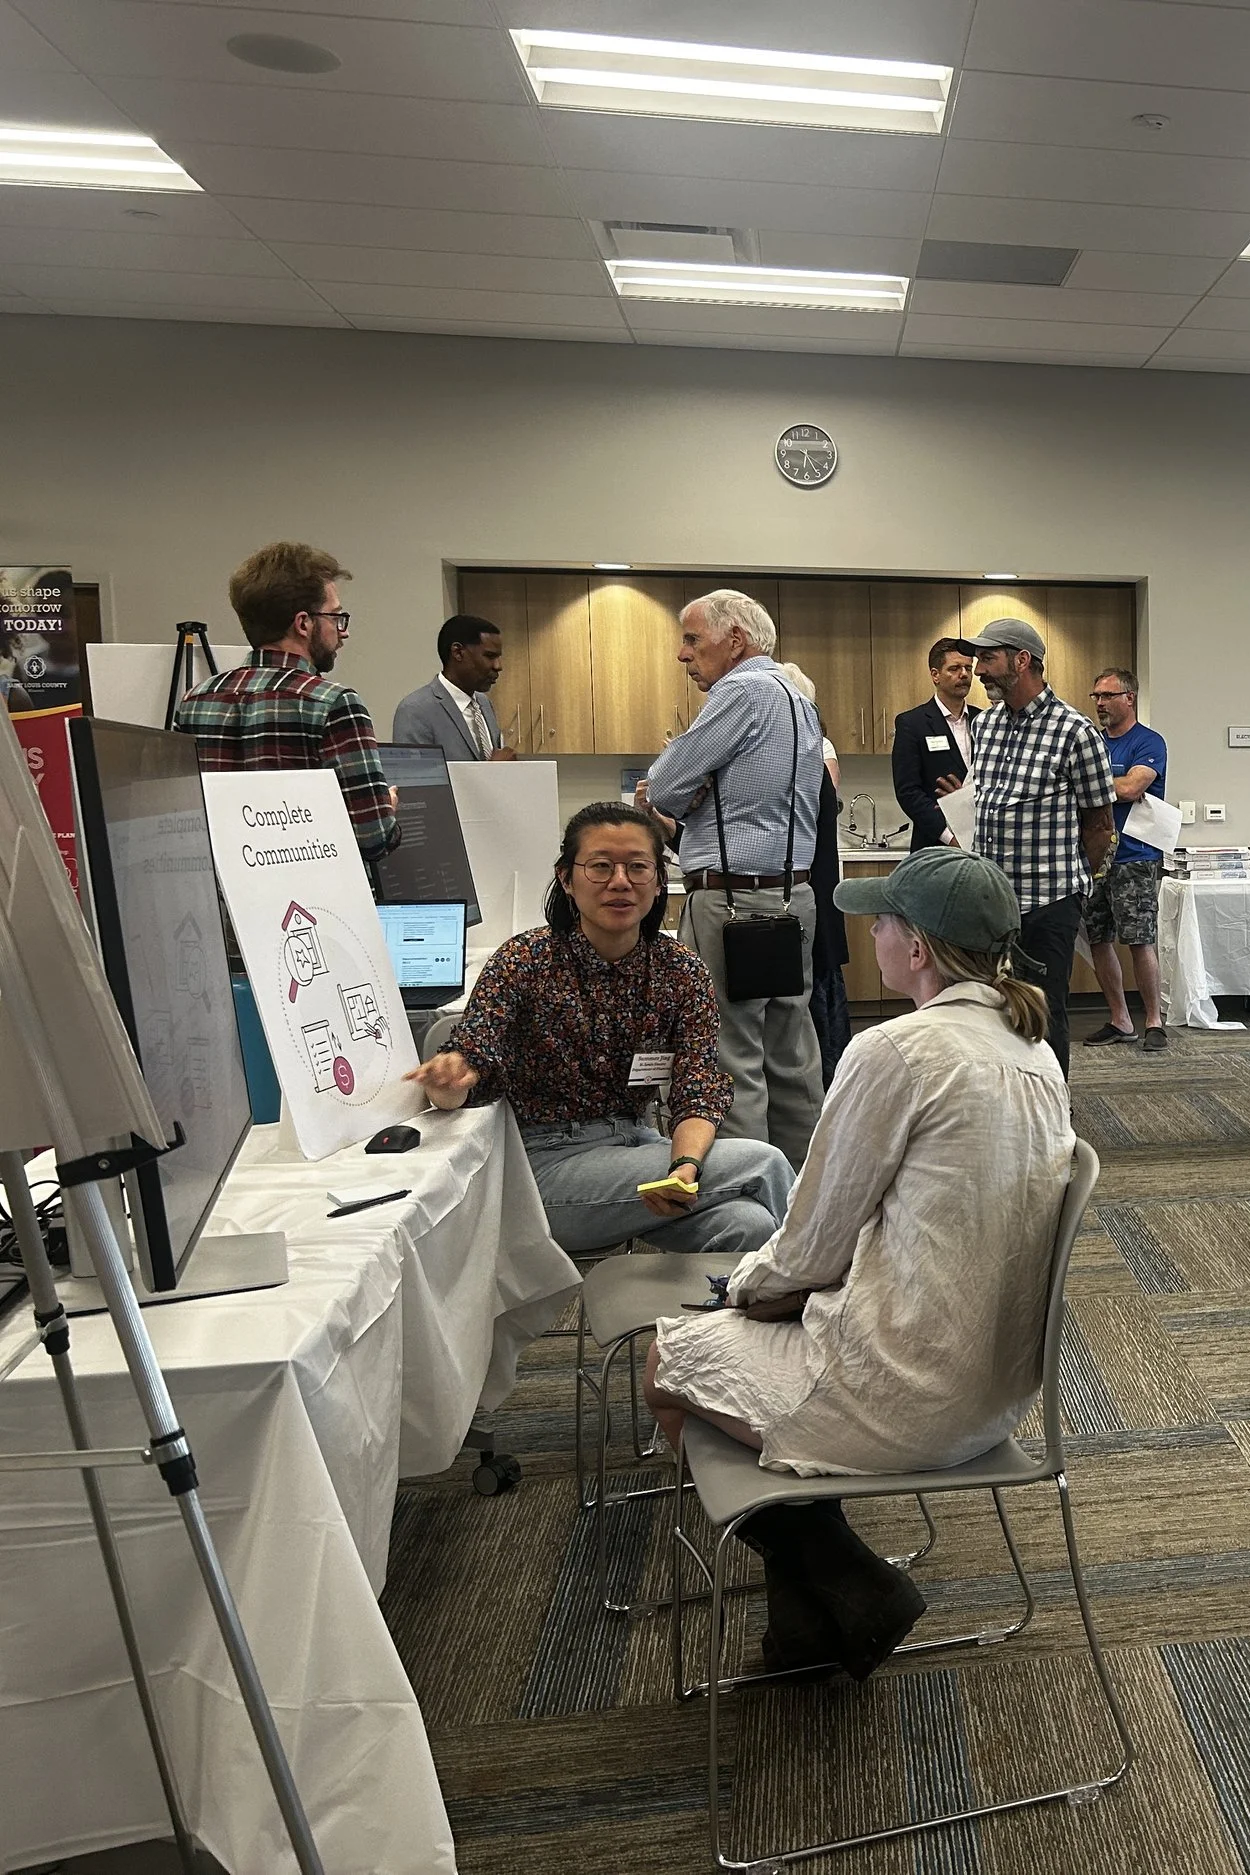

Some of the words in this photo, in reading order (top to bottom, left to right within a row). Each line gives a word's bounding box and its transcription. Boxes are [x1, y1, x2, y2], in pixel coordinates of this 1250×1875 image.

[792, 430, 799, 440] 11
[801, 428, 810, 437] 12
[822, 440, 828, 448] 2
[827, 451, 832, 459] 3
[784, 460, 790, 468] 8
[823, 462, 828, 470] 4
[794, 468, 799, 476] 7
[804, 472, 810, 480] 6
[20, 586, 61, 600] shape
[4, 620, 62, 631] TODAY!
[242, 801, 313, 830] Complete
[242, 839, 338, 867] Communities
